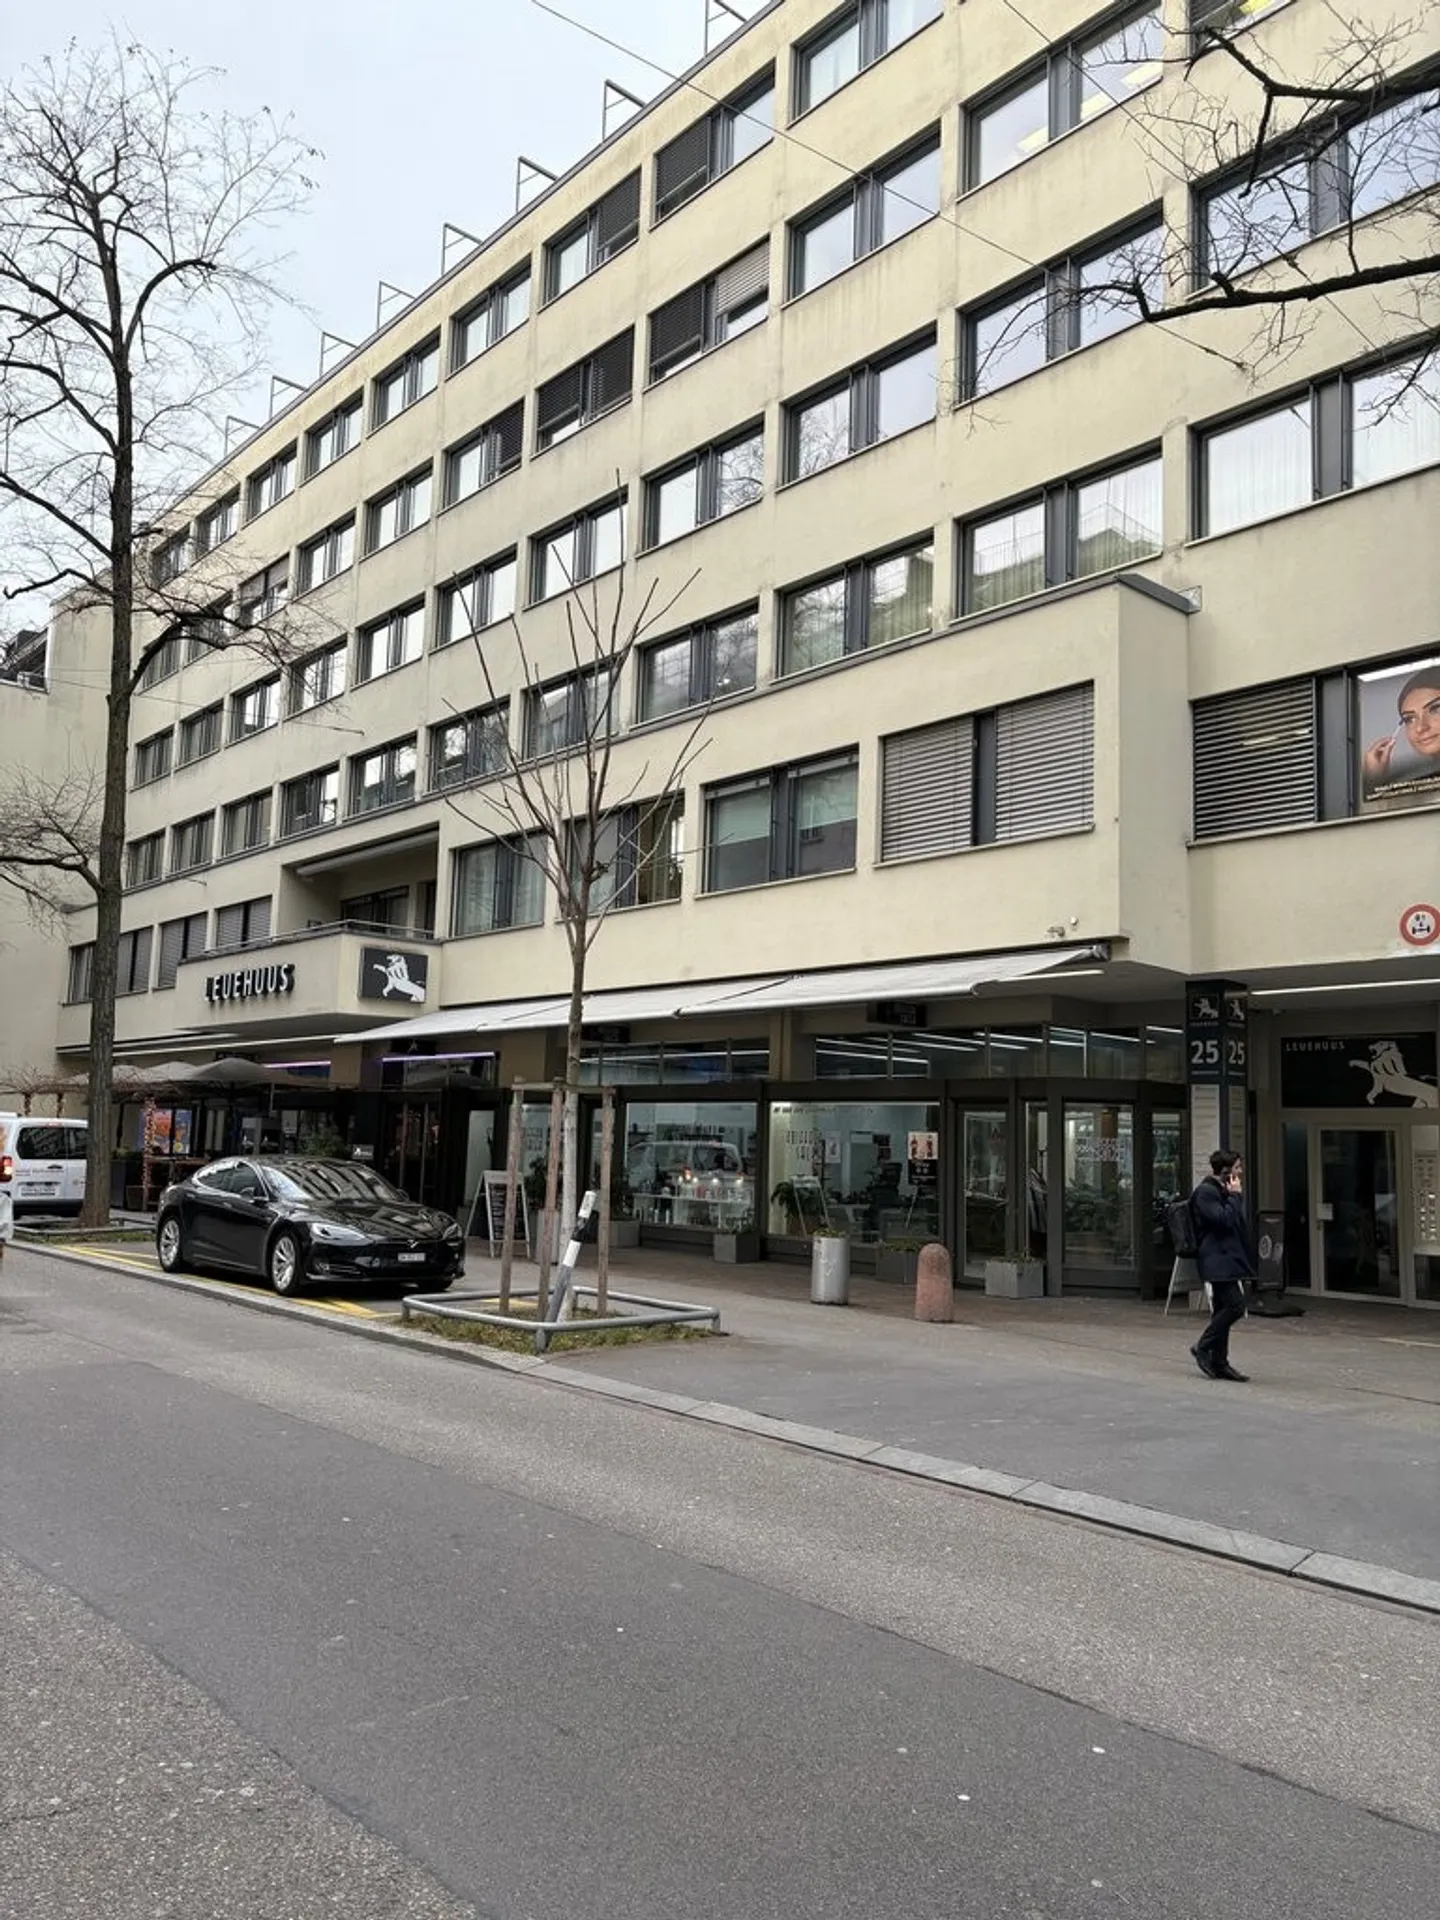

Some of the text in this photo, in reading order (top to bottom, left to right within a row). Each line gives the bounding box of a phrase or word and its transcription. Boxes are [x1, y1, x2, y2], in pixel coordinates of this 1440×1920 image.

[203, 964, 291, 1001] LEUEHUUS
[1191, 1040, 1219, 1064] 25
[1228, 1040, 1245, 1065] 25
